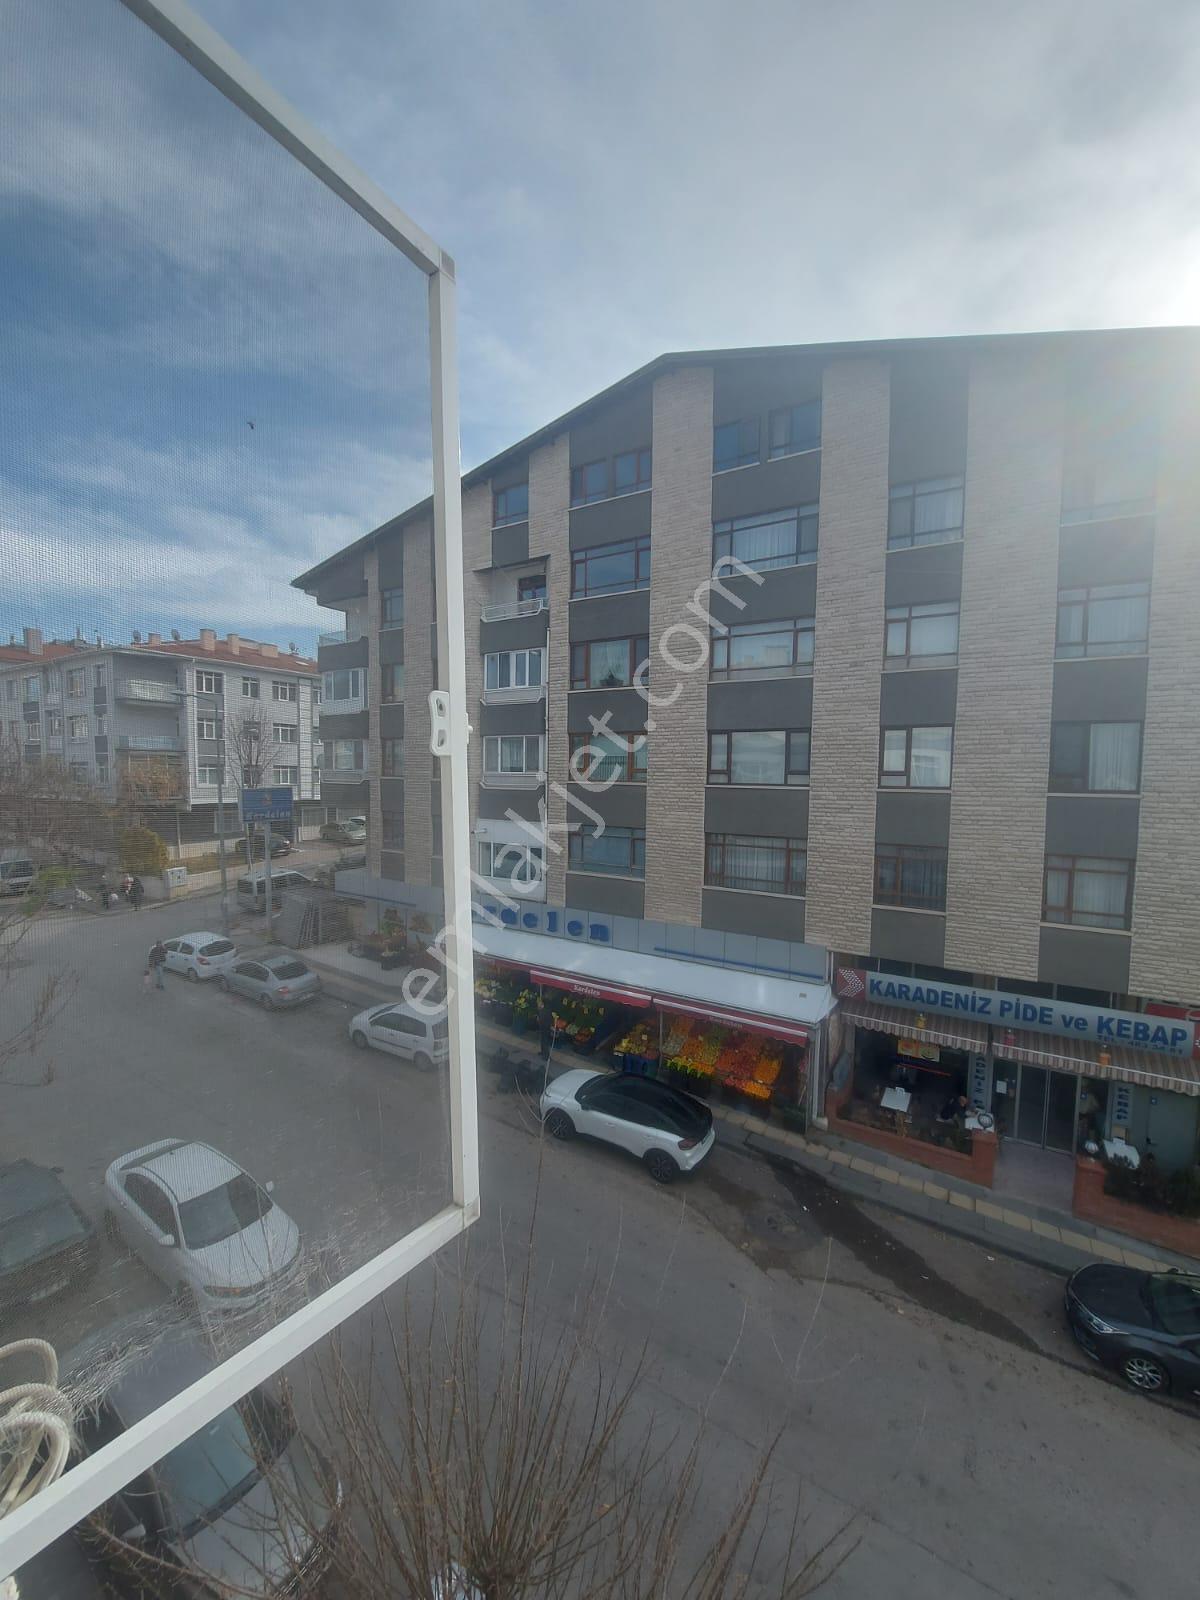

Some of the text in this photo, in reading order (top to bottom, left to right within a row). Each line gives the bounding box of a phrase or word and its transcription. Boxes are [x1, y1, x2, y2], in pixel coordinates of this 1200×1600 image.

[869, 978, 1188, 1047] KARADENİZ PİDE ve KEBAP
